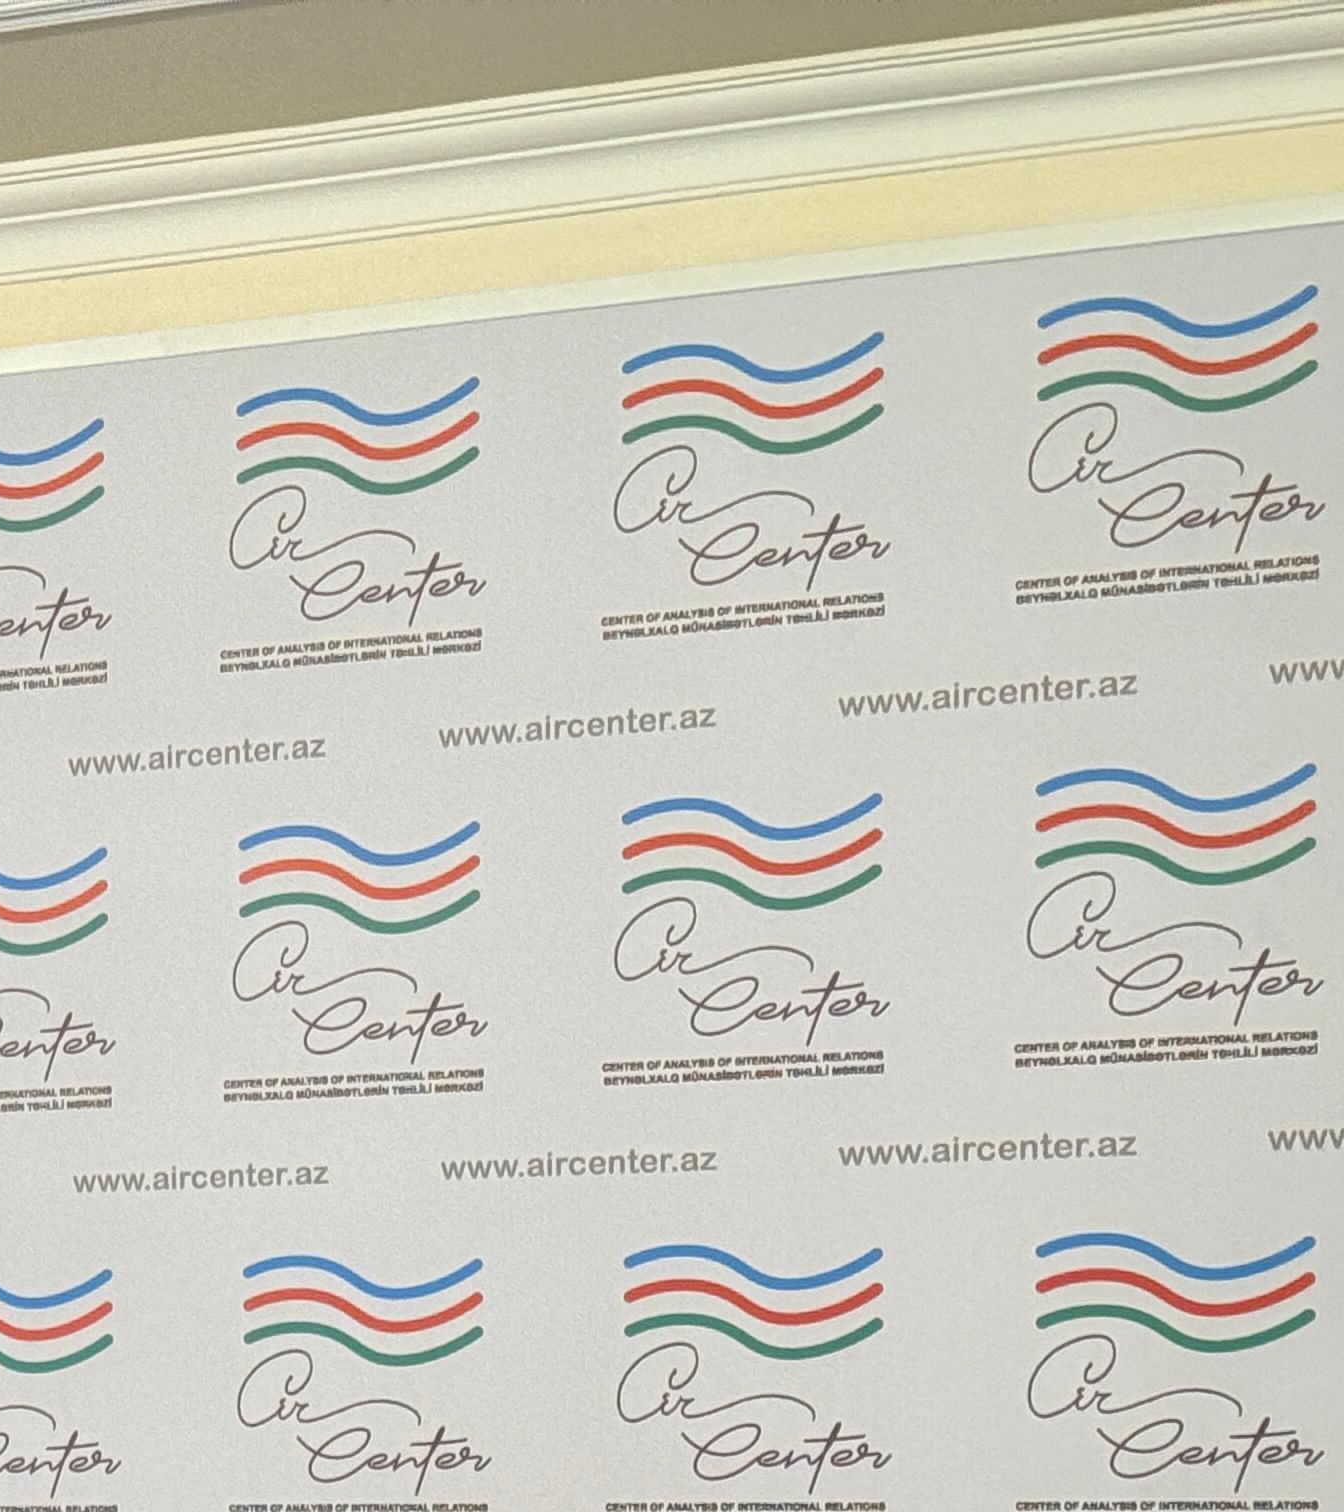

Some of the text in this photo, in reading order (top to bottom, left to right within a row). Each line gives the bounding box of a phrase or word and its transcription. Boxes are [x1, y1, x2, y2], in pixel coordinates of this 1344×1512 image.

[1097, 473, 1326, 554] Center
[678, 513, 891, 592] Center
[289, 552, 487, 628] Center
[438, 708, 717, 748] www.aircenter.az
[838, 675, 1138, 717] www.aircenter.az
[68, 738, 326, 777] www.aircenter.az
[678, 970, 890, 1047] Center
[1095, 947, 1325, 1027] Center
[291, 992, 488, 1065] Center
[73, 1163, 329, 1193] www.aircenter.az
[441, 1148, 718, 1180] www.aircenter.az
[838, 1132, 1137, 1166] www.aircenter.az
[296, 1425, 492, 1497] Center
[680, 1421, 892, 1496] Center
[1096, 1416, 1325, 1494] Center
